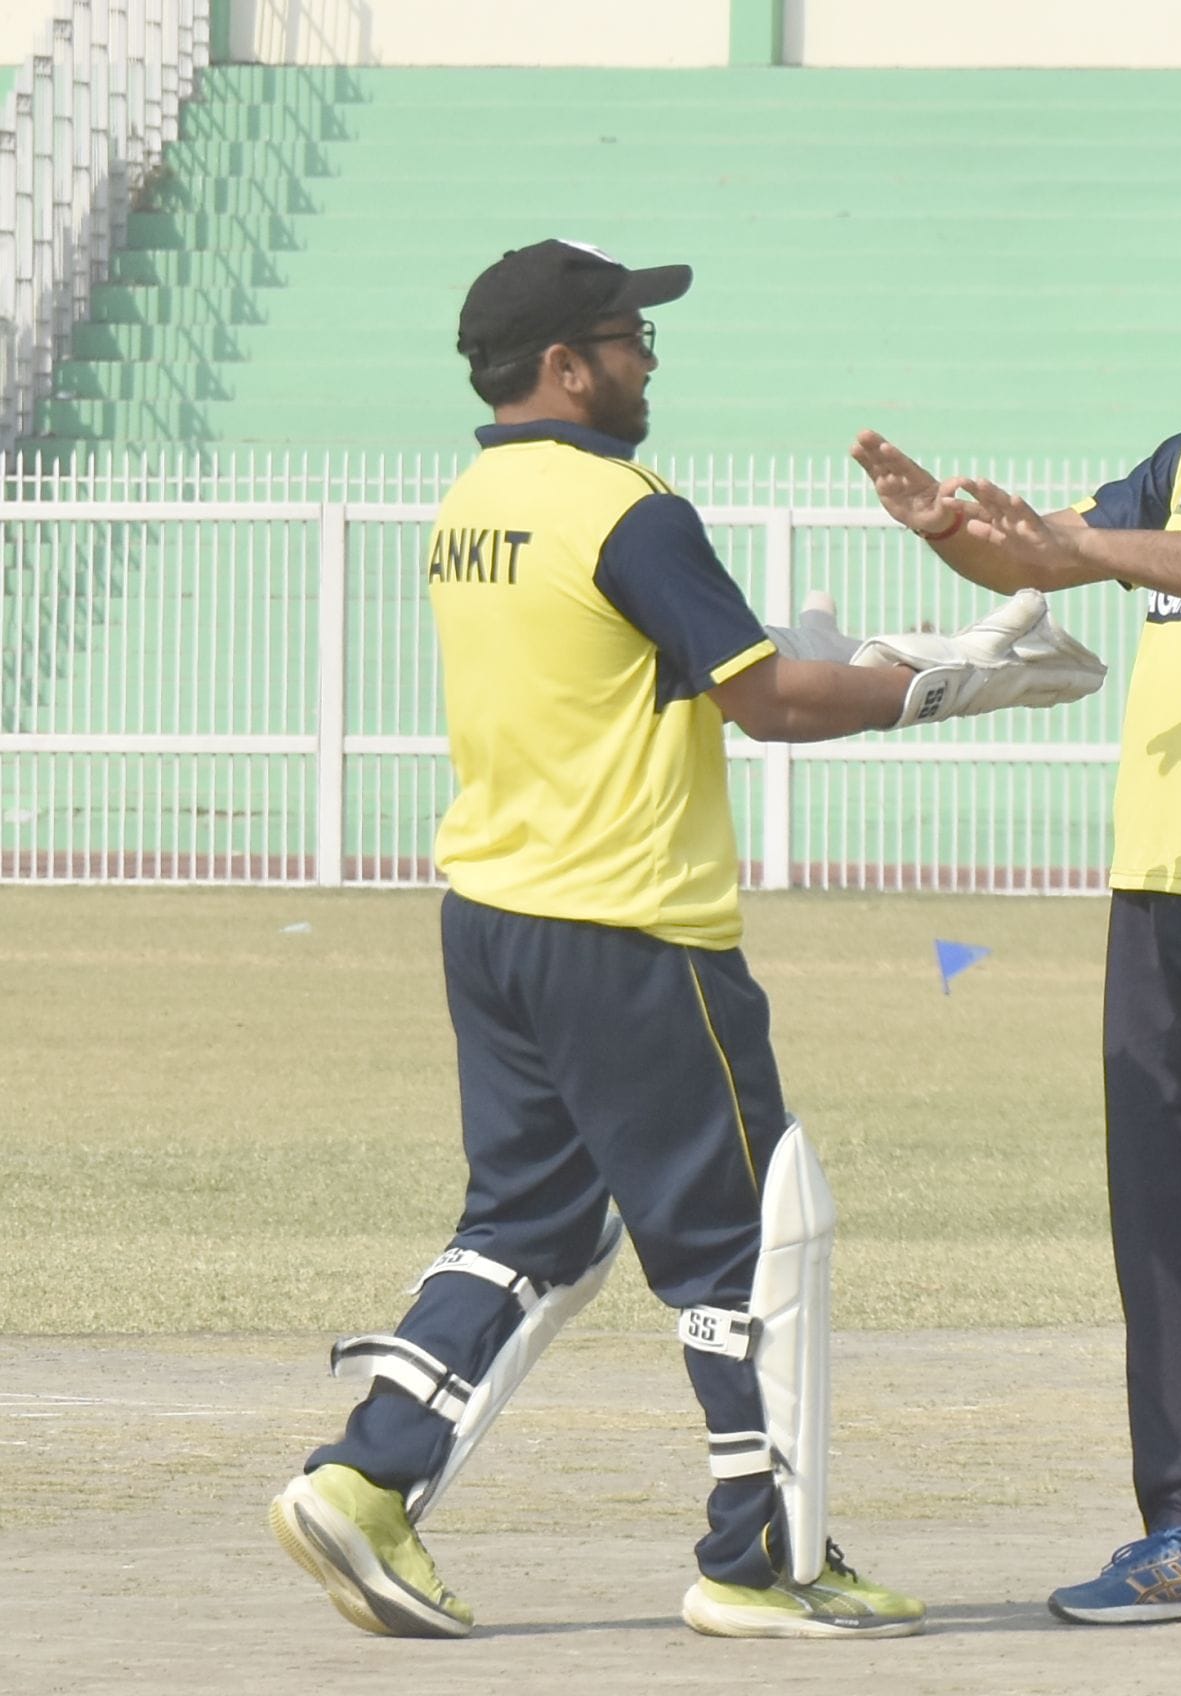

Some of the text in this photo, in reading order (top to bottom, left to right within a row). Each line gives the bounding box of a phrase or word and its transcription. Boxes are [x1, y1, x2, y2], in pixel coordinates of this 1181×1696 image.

[429, 528, 532, 584] ANKIT
[918, 687, 944, 719] SS
[689, 1311, 716, 1341] SS
